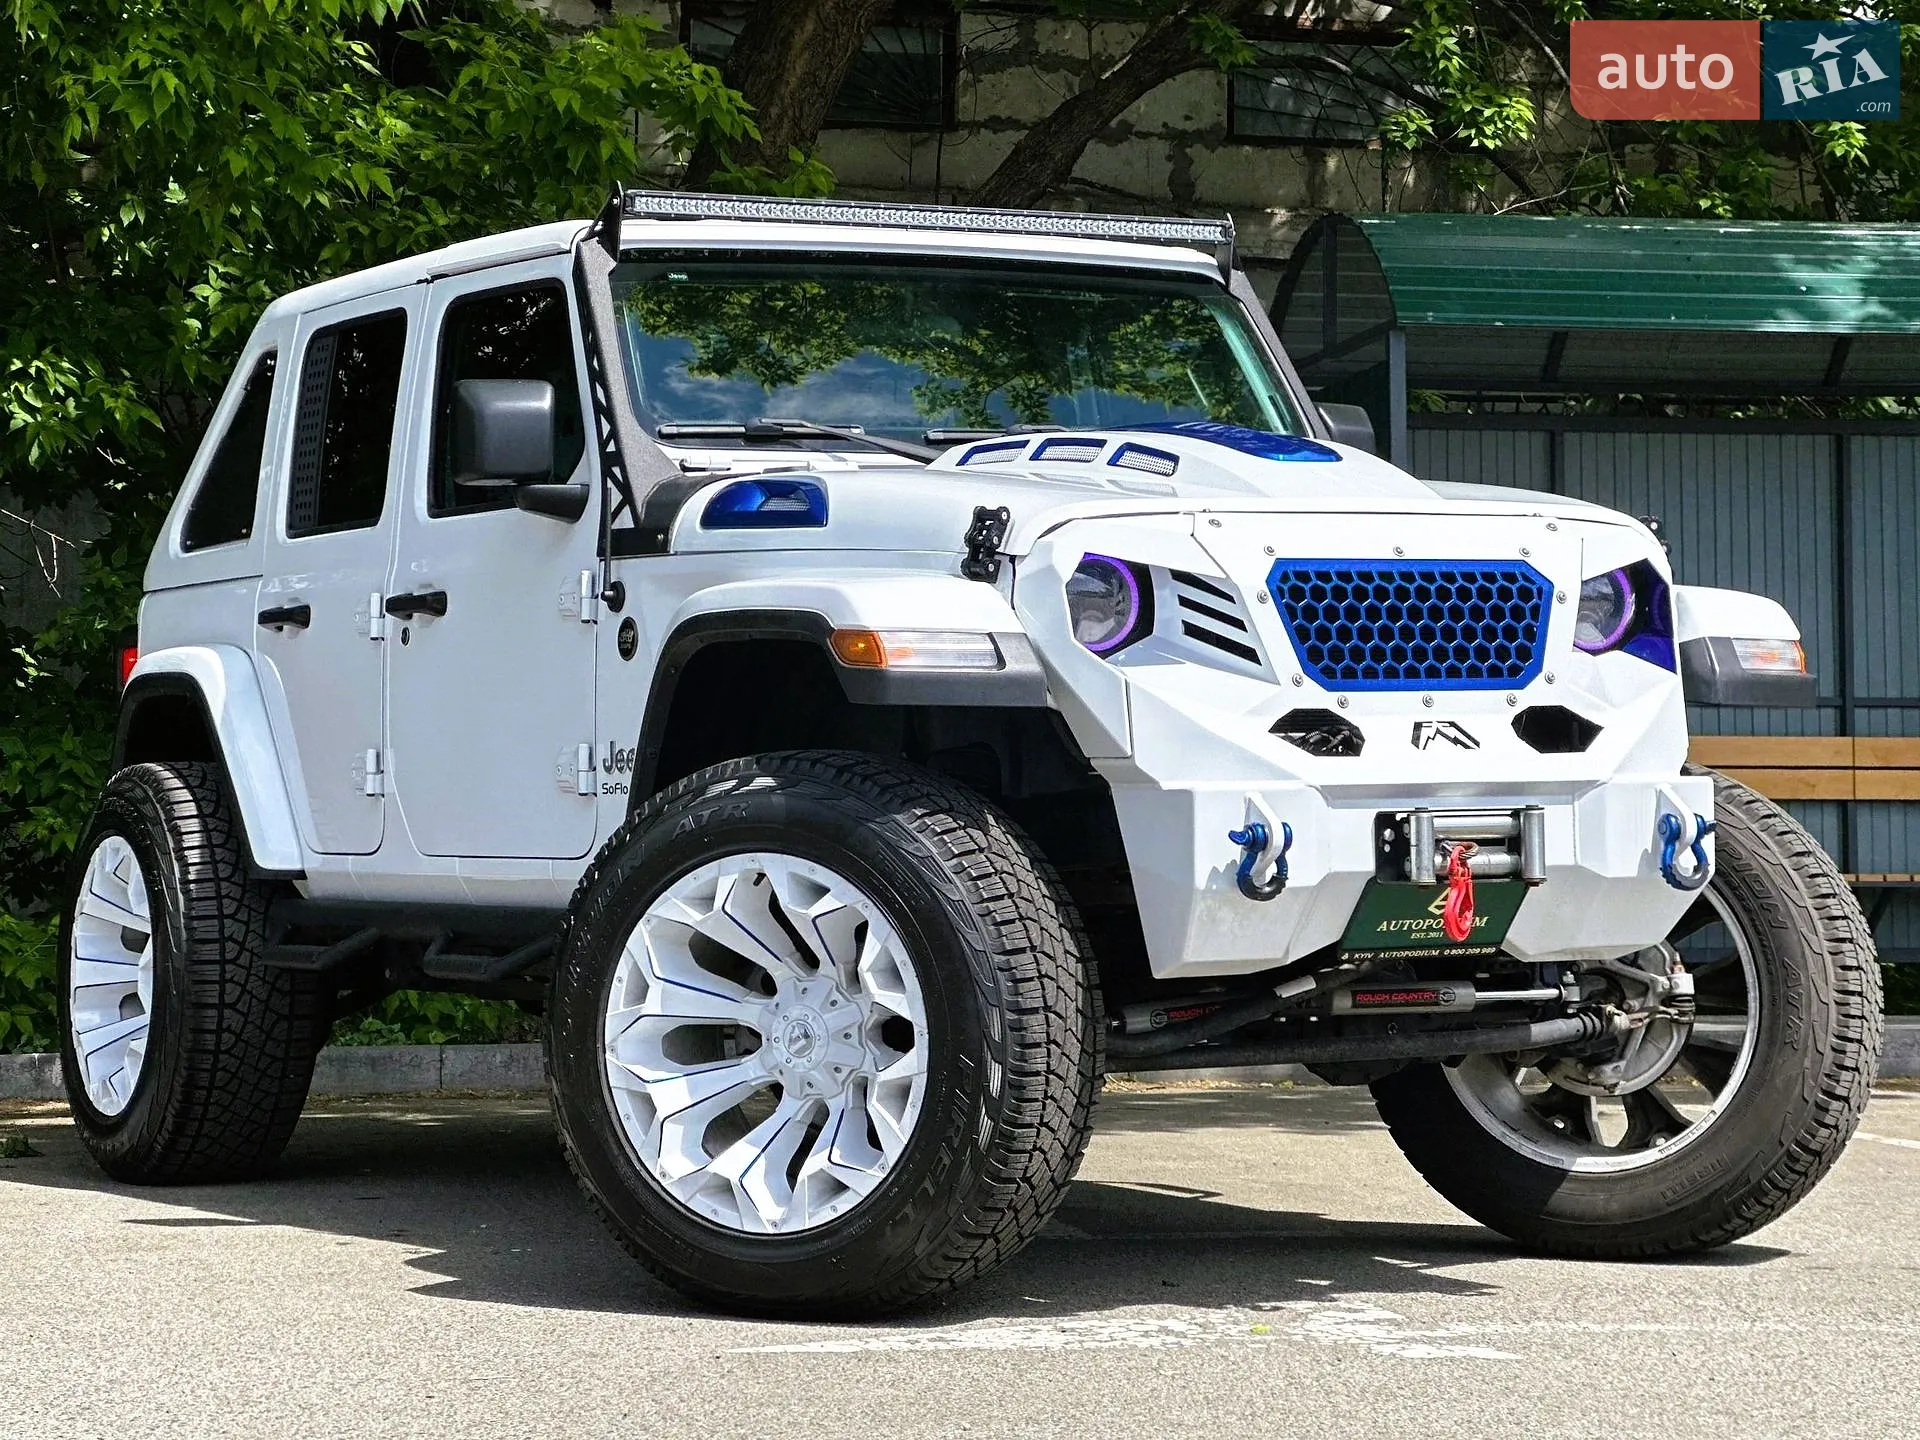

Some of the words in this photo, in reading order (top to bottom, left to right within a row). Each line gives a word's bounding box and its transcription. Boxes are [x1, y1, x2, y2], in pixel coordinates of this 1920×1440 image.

[603, 741, 636, 774] Jee
[602, 783, 628, 794] SoFlo
[1715, 838, 1788, 929] PION
[1377, 916, 1489, 931] AUTOPOM
[1379, 949, 1440, 958] AUTOPODIUM
